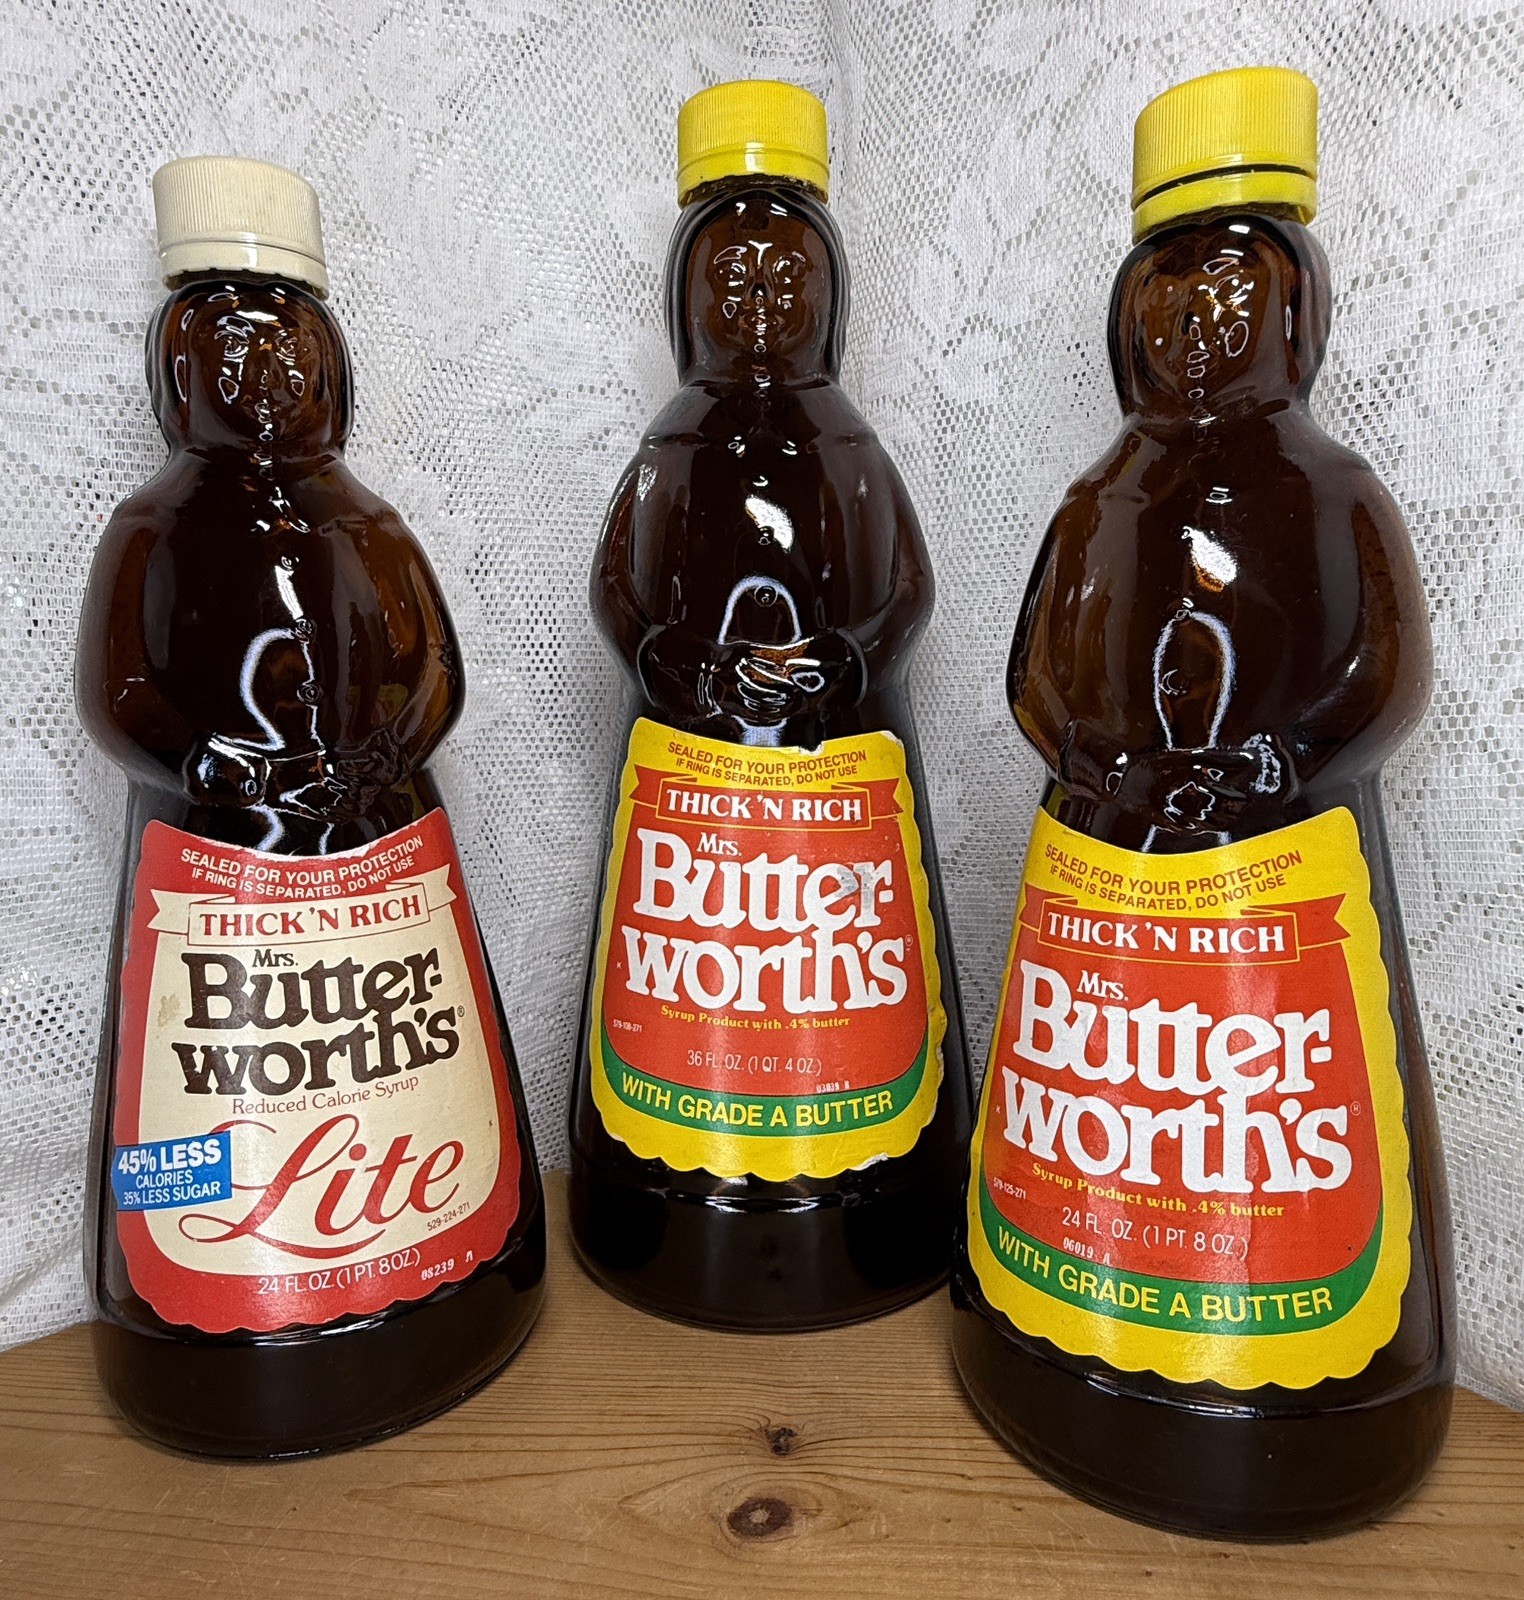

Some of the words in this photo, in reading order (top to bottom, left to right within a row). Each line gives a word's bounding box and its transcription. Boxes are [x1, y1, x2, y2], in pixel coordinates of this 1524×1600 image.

[668, 741, 714, 763] SEALED
[715, 755, 744, 770] FOR
[747, 760, 785, 775] YOUR
[788, 749, 867, 774] PROTECTION
[676, 758, 685, 767] IF
[685, 760, 711, 777] RING
[711, 767, 722, 779] IS
[724, 770, 796, 787] SEPARATED,
[796, 772, 813, 784] DO
[814, 768, 835, 782] NOT
[836, 764, 858, 777] USE
[666, 789, 751, 819] THICK
[757, 795, 784, 820] 'N
[791, 798, 862, 821] RICH
[181, 848, 241, 876] SEALED
[244, 865, 282, 884] FOR
[285, 868, 335, 885] YOUR
[338, 836, 424, 880] PROTECTION
[696, 831, 742, 857] Mrs.
[192, 867, 204, 878] IF
[204, 869, 238, 890] RING
[240, 879, 253, 892] IS
[256, 883, 346, 900] SEPARATED,
[348, 877, 367, 893] DO
[369, 866, 392, 885] NOT
[391, 856, 415, 873] USE
[633, 827, 894, 933] Butter-
[1045, 843, 1088, 875] SEALED
[1089, 867, 1124, 889] FOR
[1129, 876, 1181, 896] YOUR
[1185, 849, 1302, 895] PROTECTION
[1050, 864, 1059, 876] IF
[1059, 869, 1083, 890] RING
[1084, 880, 1097, 895] IS
[1098, 887, 1193, 911] SEPARATED,
[1195, 895, 1219, 910] DO
[1222, 884, 1254, 904] NOT
[1256, 874, 1287, 891] USE
[199, 912, 303, 936] THICK
[309, 906, 339, 930] 'N
[350, 895, 421, 928] RICH
[1047, 912, 1137, 949] THICK
[1146, 923, 1177, 953] 'N
[1189, 926, 1284, 954] RICH
[252, 949, 299, 968] Mrs.
[181, 947, 442, 1030] Butter-
[1077, 970, 1128, 1002] Mrs.
[661, 1004, 695, 1023] Syrup
[698, 1013, 749, 1029] Product
[751, 1018, 782, 1032] with
[812, 1016, 850, 1028] butter
[1012, 959, 1332, 1096] Butter-
[687, 1050, 703, 1066] 36
[725, 1054, 745, 1070] OZ.
[748, 1055, 758, 1075] (1
[762, 1056, 781, 1072] QT.
[785, 1058, 793, 1072] 4
[232, 1095, 306, 1115] Reduced
[311, 1088, 371, 1108] Calorie
[375, 1076, 419, 1099] Syrup
[621, 1072, 670, 1111] WITH
[678, 1094, 763, 1128] GRADE
[770, 1104, 788, 1127] A
[796, 1090, 893, 1127] BUTTER
[118, 1148, 157, 1174] 45%
[160, 1138, 222, 1171] LESS
[123, 1191, 140, 1205] 35%
[143, 1188, 170, 1204] LESS
[173, 1181, 221, 1201] SUGAR
[136, 1169, 194, 1189] CALORIES
[179, 1113, 464, 1260] Lite
[1032, 1162, 1074, 1190] Syrup
[1077, 1178, 1142, 1206] Product
[1146, 1195, 1187, 1212] with
[1192, 1199, 1227, 1216] .4%
[1230, 1201, 1284, 1217] butter
[427, 1201, 470, 1231] 529-224-271
[1062, 1206, 1081, 1228] 24
[1111, 1218, 1137, 1241] OZ.
[1142, 1225, 1159, 1248] (1
[1166, 1227, 1187, 1249] PT.
[1193, 1231, 1206, 1252] 8
[998, 1225, 1050, 1279] WITH
[1058, 1264, 1160, 1314] GRADE
[1169, 1292, 1191, 1319] A
[1202, 1287, 1333, 1322] BUTTER
[1102, 1252, 1111, 1267] A
[258, 1277, 279, 1294] 24
